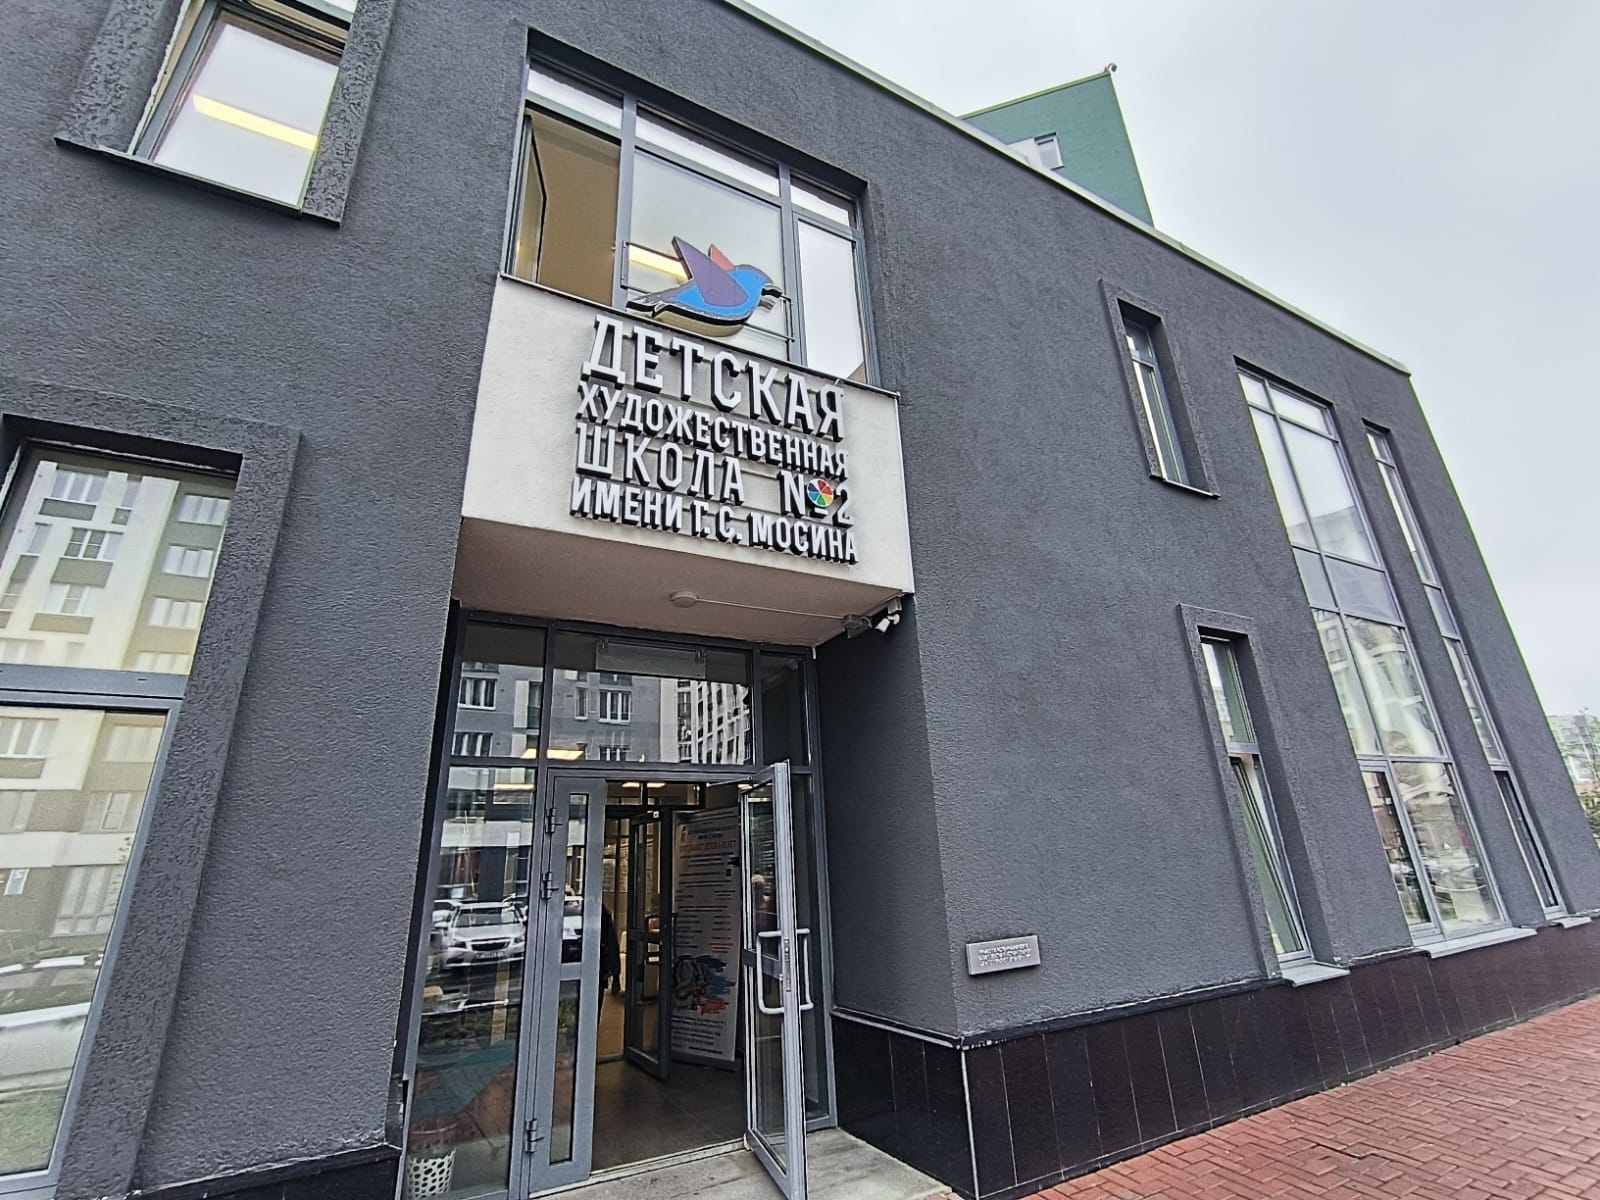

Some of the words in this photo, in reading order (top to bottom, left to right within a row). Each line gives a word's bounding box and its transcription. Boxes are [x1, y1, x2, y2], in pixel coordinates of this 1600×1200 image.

[580, 314, 844, 442] ДЕТСКАЯ
[575, 381, 848, 479] ХУДОЖЕСТВЕННАЯ
[576, 423, 744, 505] ШКОЛА
[570, 477, 682, 533] ИМЕНИ
[747, 512, 858, 564] МОСИНА
